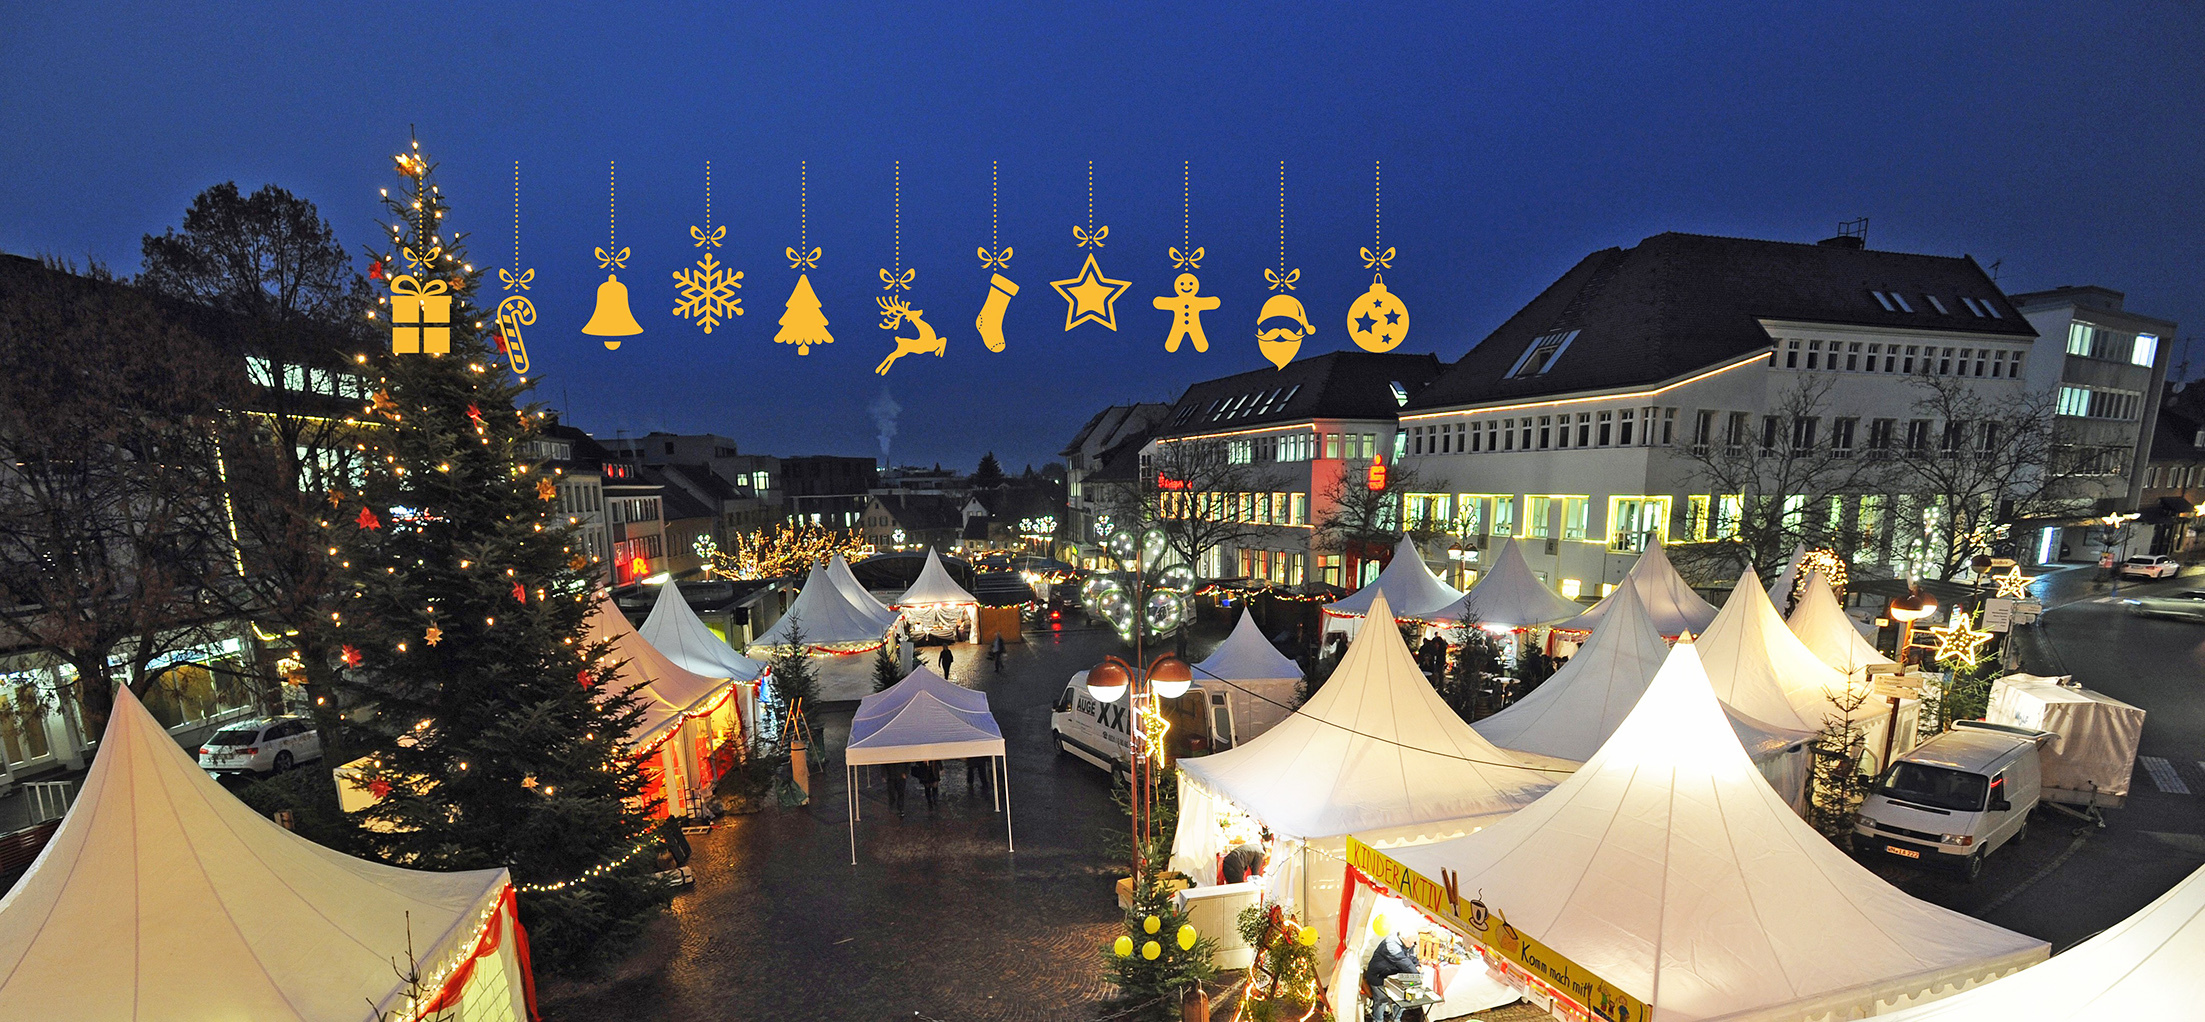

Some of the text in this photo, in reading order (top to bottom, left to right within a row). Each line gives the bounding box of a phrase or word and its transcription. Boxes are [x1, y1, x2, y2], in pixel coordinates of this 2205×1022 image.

[1077, 698, 1096, 716] AUGE
[1353, 842, 1443, 913] KINDERAKTIV
[1521, 941, 1548, 975] Komm
[1549, 966, 1570, 988] mach
